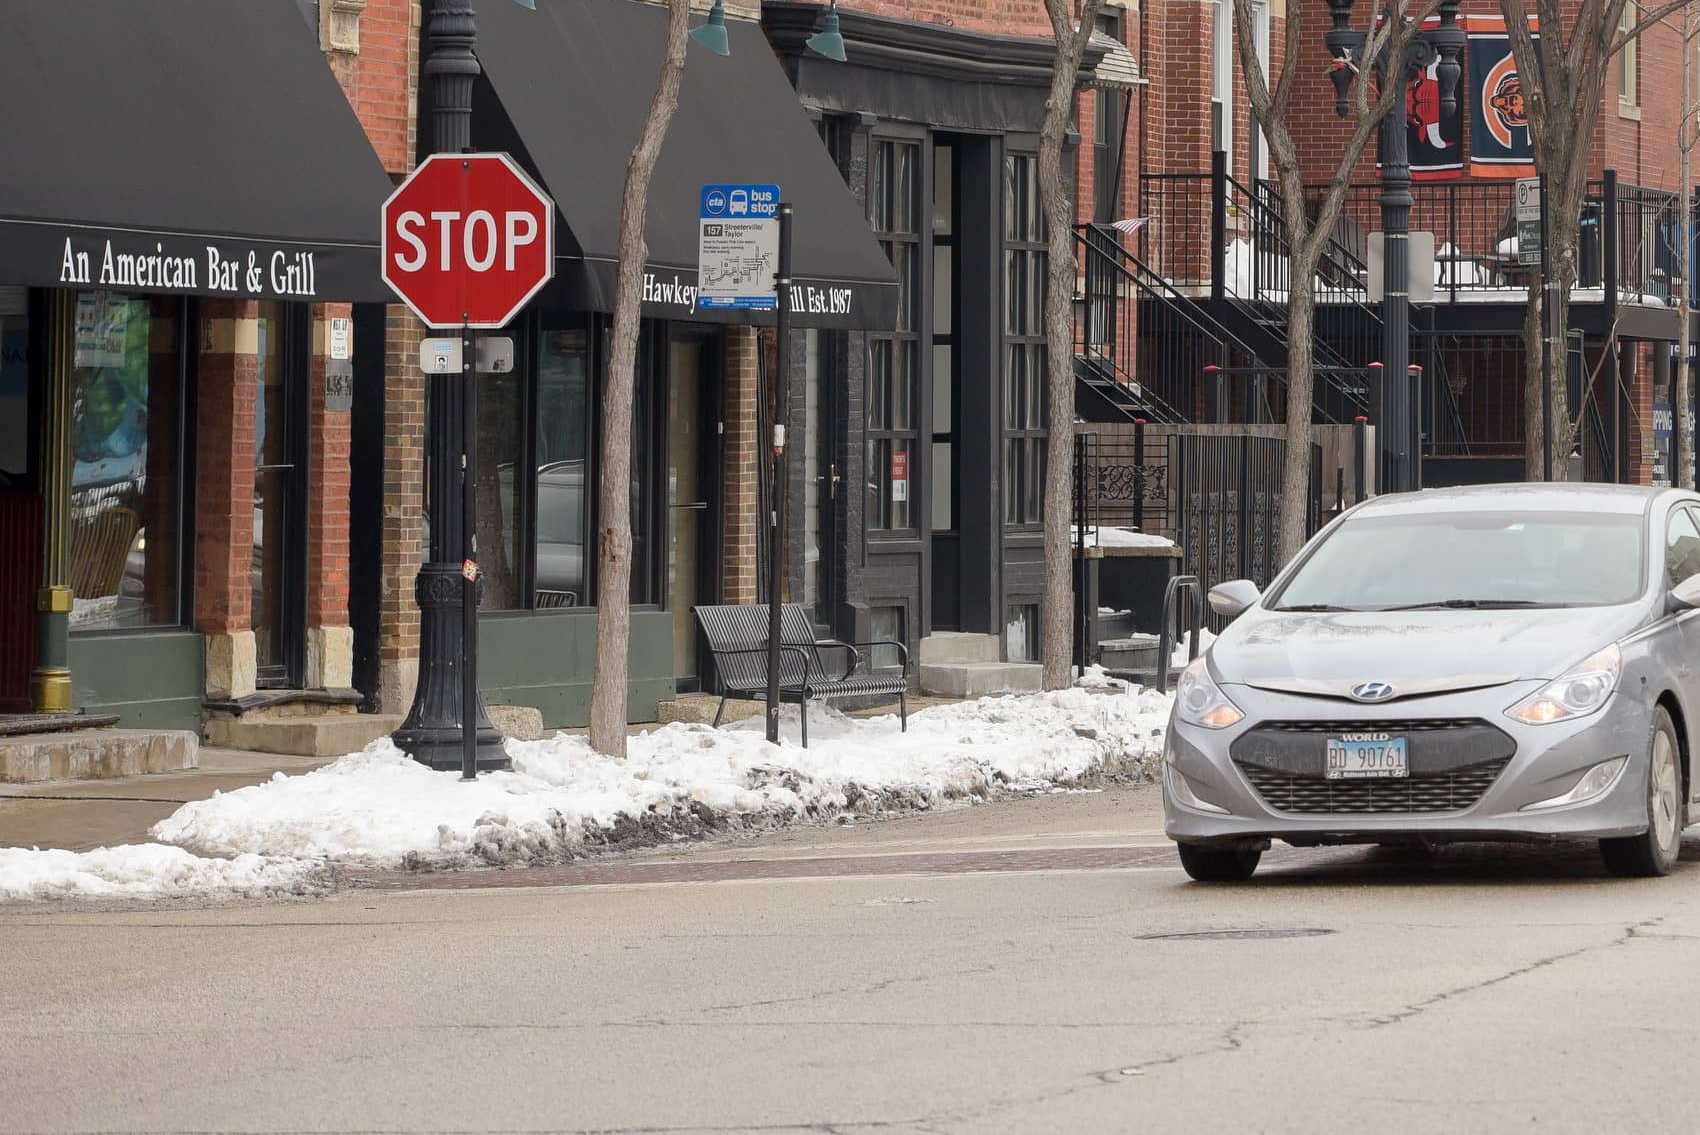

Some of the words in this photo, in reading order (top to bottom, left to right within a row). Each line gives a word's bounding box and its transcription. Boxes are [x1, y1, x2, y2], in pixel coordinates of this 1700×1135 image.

[708, 198, 724, 207] cta
[751, 189, 772, 202] bus
[751, 202, 776, 216] stop
[706, 225, 721, 236] 157
[724, 231, 743, 239] Taylor
[394, 210, 538, 272] STOP
[60, 237, 91, 283] An
[99, 239, 197, 288] American
[206, 246, 239, 291] Bar
[246, 250, 263, 293] &
[270, 250, 316, 296] Grill
[642, 273, 698, 314] Hawkey
[830, 287, 852, 314] 1987
[1342, 732, 1389, 742] WORLD
[1328, 747, 1347, 769] BD
[1357, 746, 1403, 768] 90761
